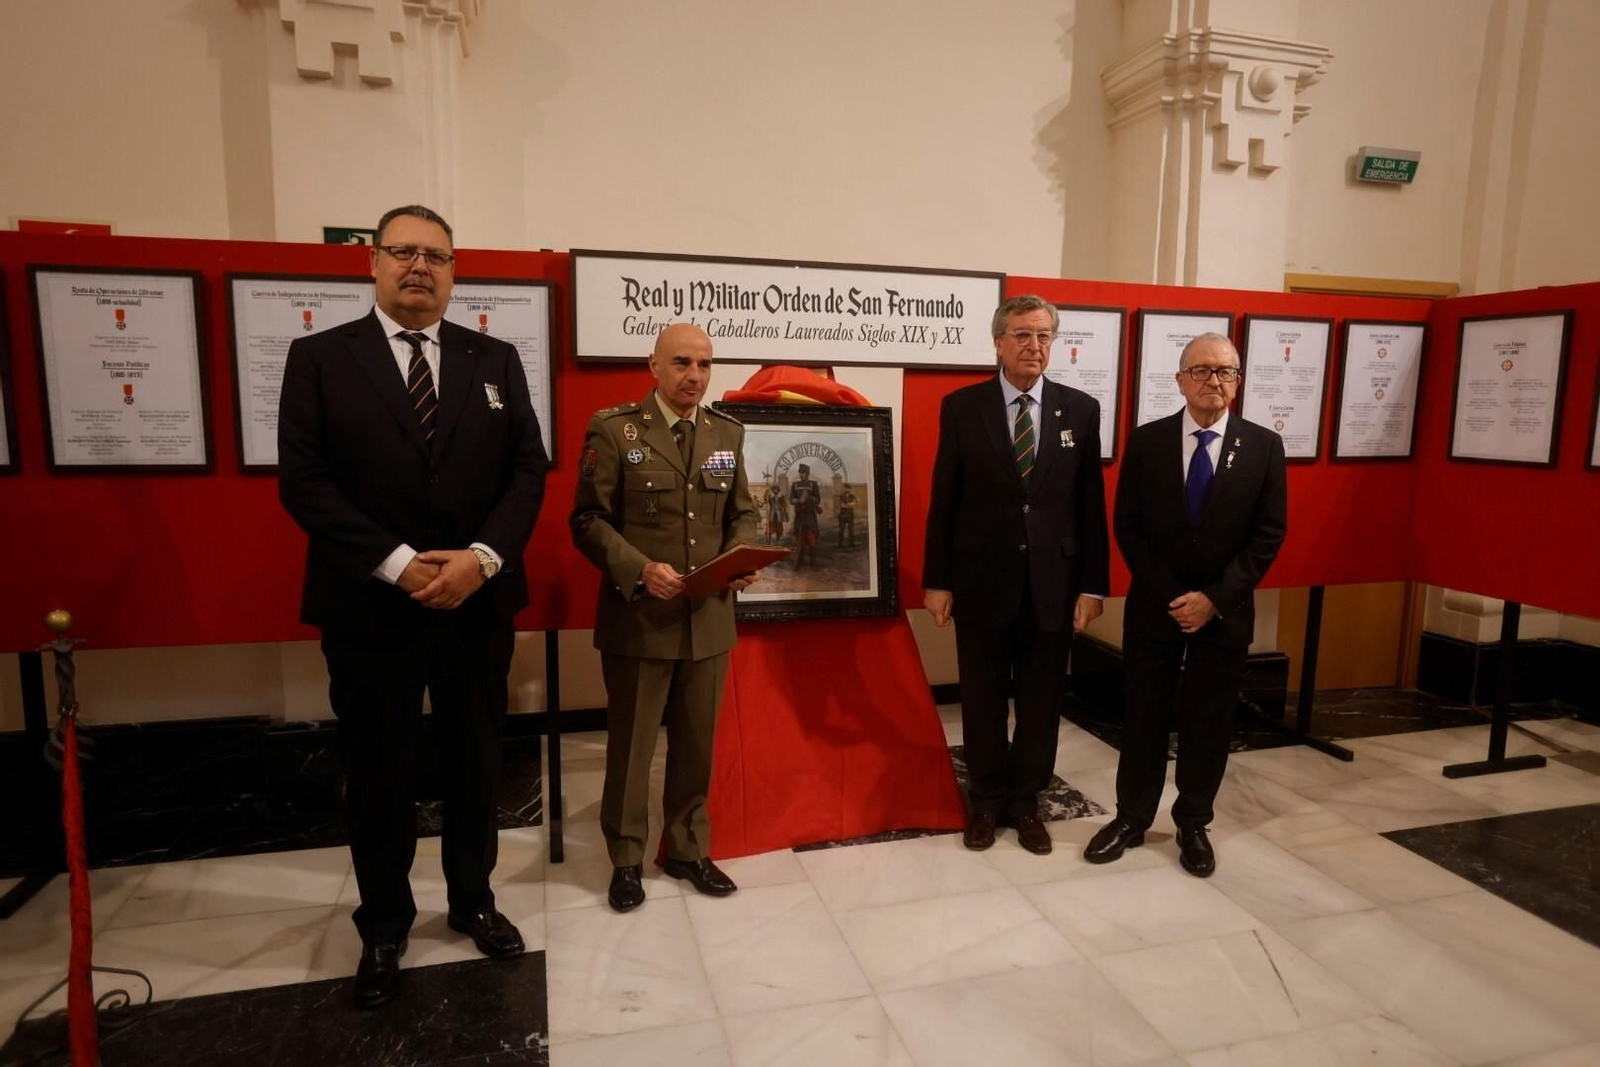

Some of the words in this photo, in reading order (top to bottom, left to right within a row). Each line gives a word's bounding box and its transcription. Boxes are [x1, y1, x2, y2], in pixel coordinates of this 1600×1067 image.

[1365, 168, 1409, 181] EMERGENCIA
[1371, 158, 1396, 169] SALIDA
[1398, 161, 1410, 171] DE
[621, 276, 668, 312] Real
[673, 288, 683, 316] y
[690, 280, 760, 312] Militar
[763, 284, 821, 314] Orden
[825, 287, 843, 314] de
[847, 286, 882, 317] San
[885, 288, 964, 319] Fernando
[623, 315, 673, 338] Galerí
[707, 317, 779, 339] Caballeros
[784, 320, 854, 341] Laureados
[857, 324, 896, 348] Siglos
[899, 325, 929, 344] XIX
[929, 331, 938, 350] y
[941, 326, 965, 345] XX
[790, 443, 842, 472] ANIVERSARIO
